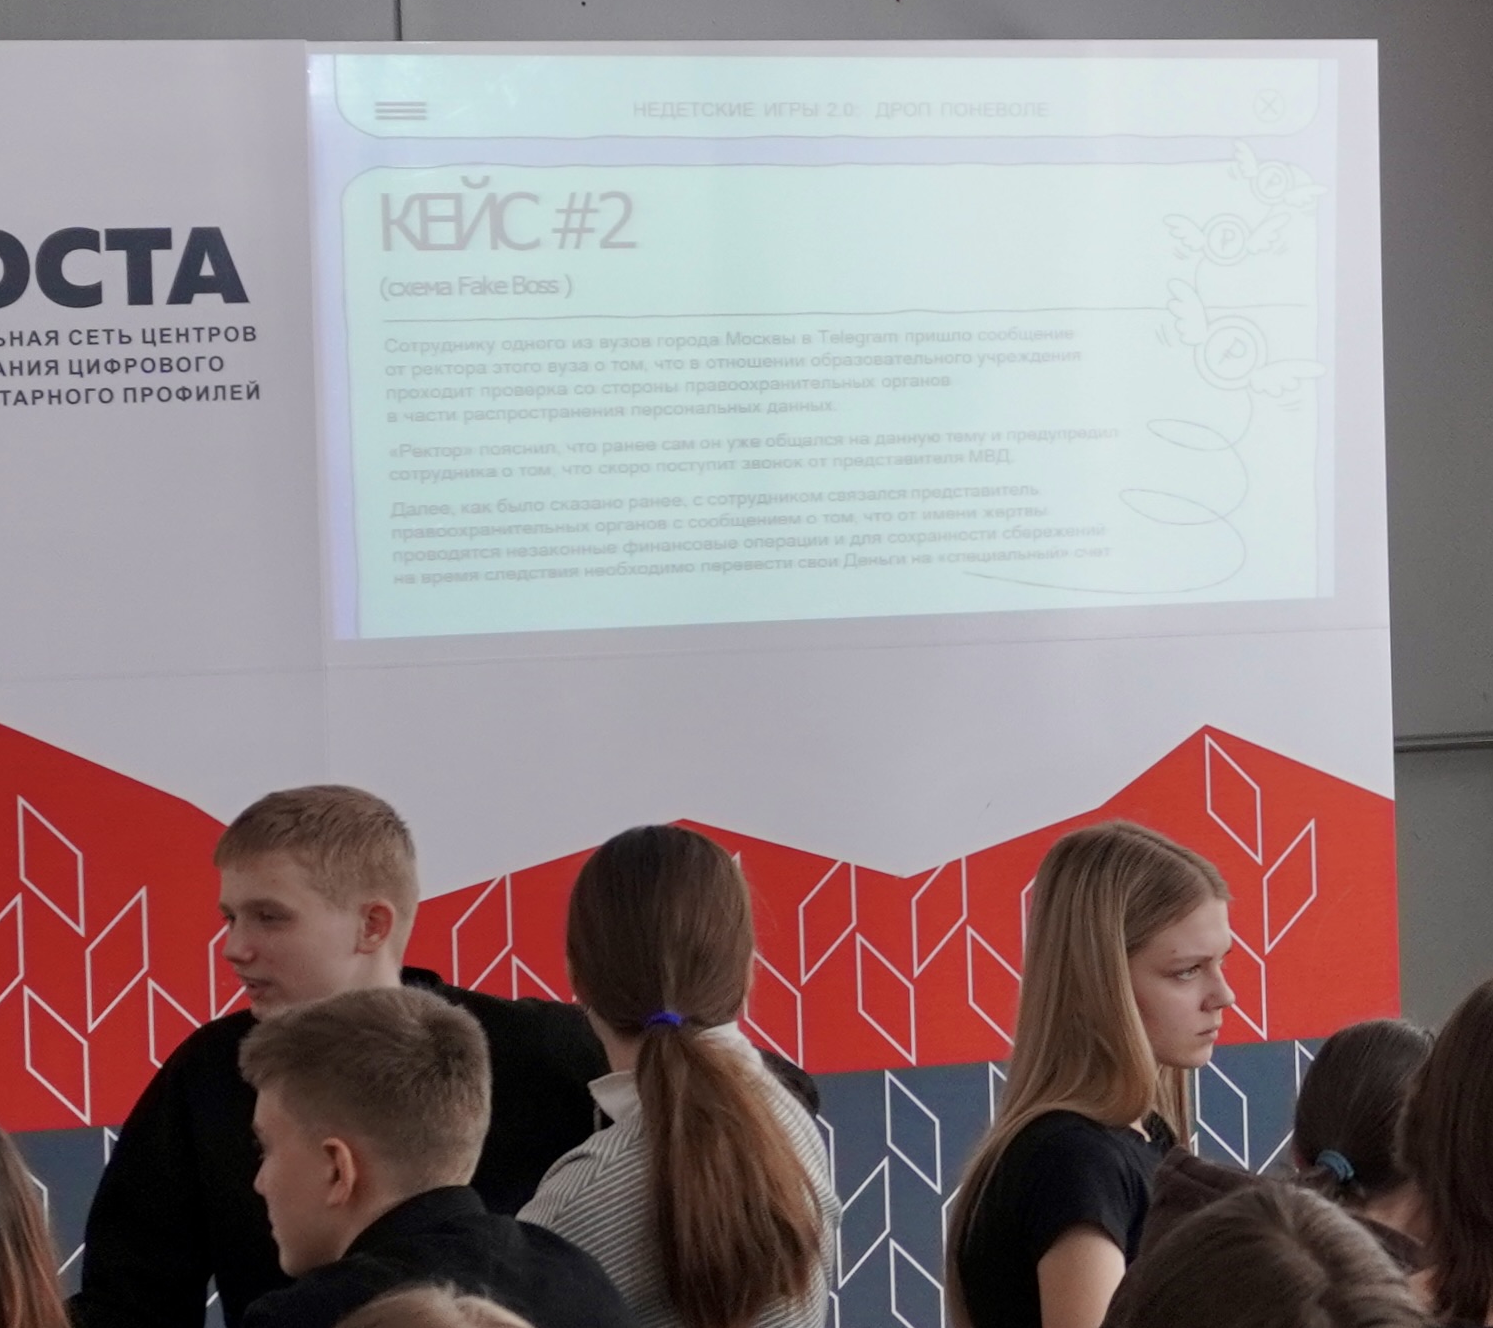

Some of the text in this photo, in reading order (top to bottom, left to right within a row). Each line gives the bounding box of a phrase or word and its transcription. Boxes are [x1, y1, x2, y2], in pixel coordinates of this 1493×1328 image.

[633, 101, 755, 119] НЕДЕТСКИЕ
[763, 101, 821, 117] ИГРЫ
[875, 101, 933, 120] ДРОП
[939, 101, 1049, 118] ПОНЕВОЛЕ
[381, 175, 639, 251] КЕЙС #2
[459, 275, 509, 296] Fake
[68, 328, 133, 346] СЕТЬ
[141, 325, 257, 347] ЦЕНТРОВ
[383, 326, 1075, 356] Сотруднику одного из вузов города Москвы в Telegram пришло сообщение
[68, 355, 224, 378] ЦИФРОВОГО
[385, 364, 407, 377] от
[411, 363, 489, 379] ректора
[493, 361, 543, 374] этого
[547, 360, 591, 377] вуза
[593, 360, 607, 372] о
[653, 358, 685, 370] что
[689, 358, 701, 370] в
[705, 356, 807, 369] отношении
[809, 351, 973, 368] образовательного
[977, 351, 1083, 368] учреждения
[123, 380, 260, 403] ПРОФИЛЕЙ
[387, 375, 951, 403] проходит проверка со стороны правоохранительных органов
[387, 411, 399, 423] в
[403, 410, 457, 422] части
[463, 405, 627, 424] распространения
[631, 403, 761, 418] персональных
[567, 441, 597, 453] что
[601, 440, 657, 456] ранее
[661, 439, 695, 451] сам
[699, 438, 721, 450] он
[727, 437, 761, 452] уже
[765, 432, 845, 448] общался
[849, 434, 871, 445] на
[875, 432, 941, 447] данную
[947, 431, 987, 445] тему
[991, 431, 1001, 441] и
[389, 467, 499, 484] сотрудника
[501, 466, 515, 478] о
[561, 464, 593, 475] что
[597, 462, 653, 476] скоро
[655, 459, 737, 474] поступит
[741, 458, 803, 470] звонок
[807, 456, 829, 468] от
[831, 453, 965, 470] представителя
[461, 502, 493, 514] как
[495, 497, 545, 514] было
[549, 498, 625, 511] сказано
[693, 495, 703, 507] с
[707, 491, 823, 509] сотрудником
[827, 488, 907, 502] связался
[391, 522, 589, 540] правоохранительных
[595, 518, 669, 535] органов
[673, 518, 683, 530] с
[687, 512, 803, 528] сообщением
[805, 513, 817, 525] о
[863, 511, 893, 522] что
[897, 510, 917, 522] от
[921, 509, 977, 520] имени
[393, 547, 501, 565] проводятся
[505, 543, 617, 558] незаконные
[623, 539, 739, 556] финансовые
[743, 535, 829, 551] операции
[835, 534, 845, 546] и
[849, 533, 883, 547] для
[887, 529, 997, 546] сохранности
[393, 573, 417, 585] на
[421, 571, 481, 587] время
[483, 567, 581, 582] следствия
[583, 561, 695, 577] необходимо
[701, 559, 793, 574] перевести
[797, 557, 839, 569] свои
[911, 554, 933, 564] на
